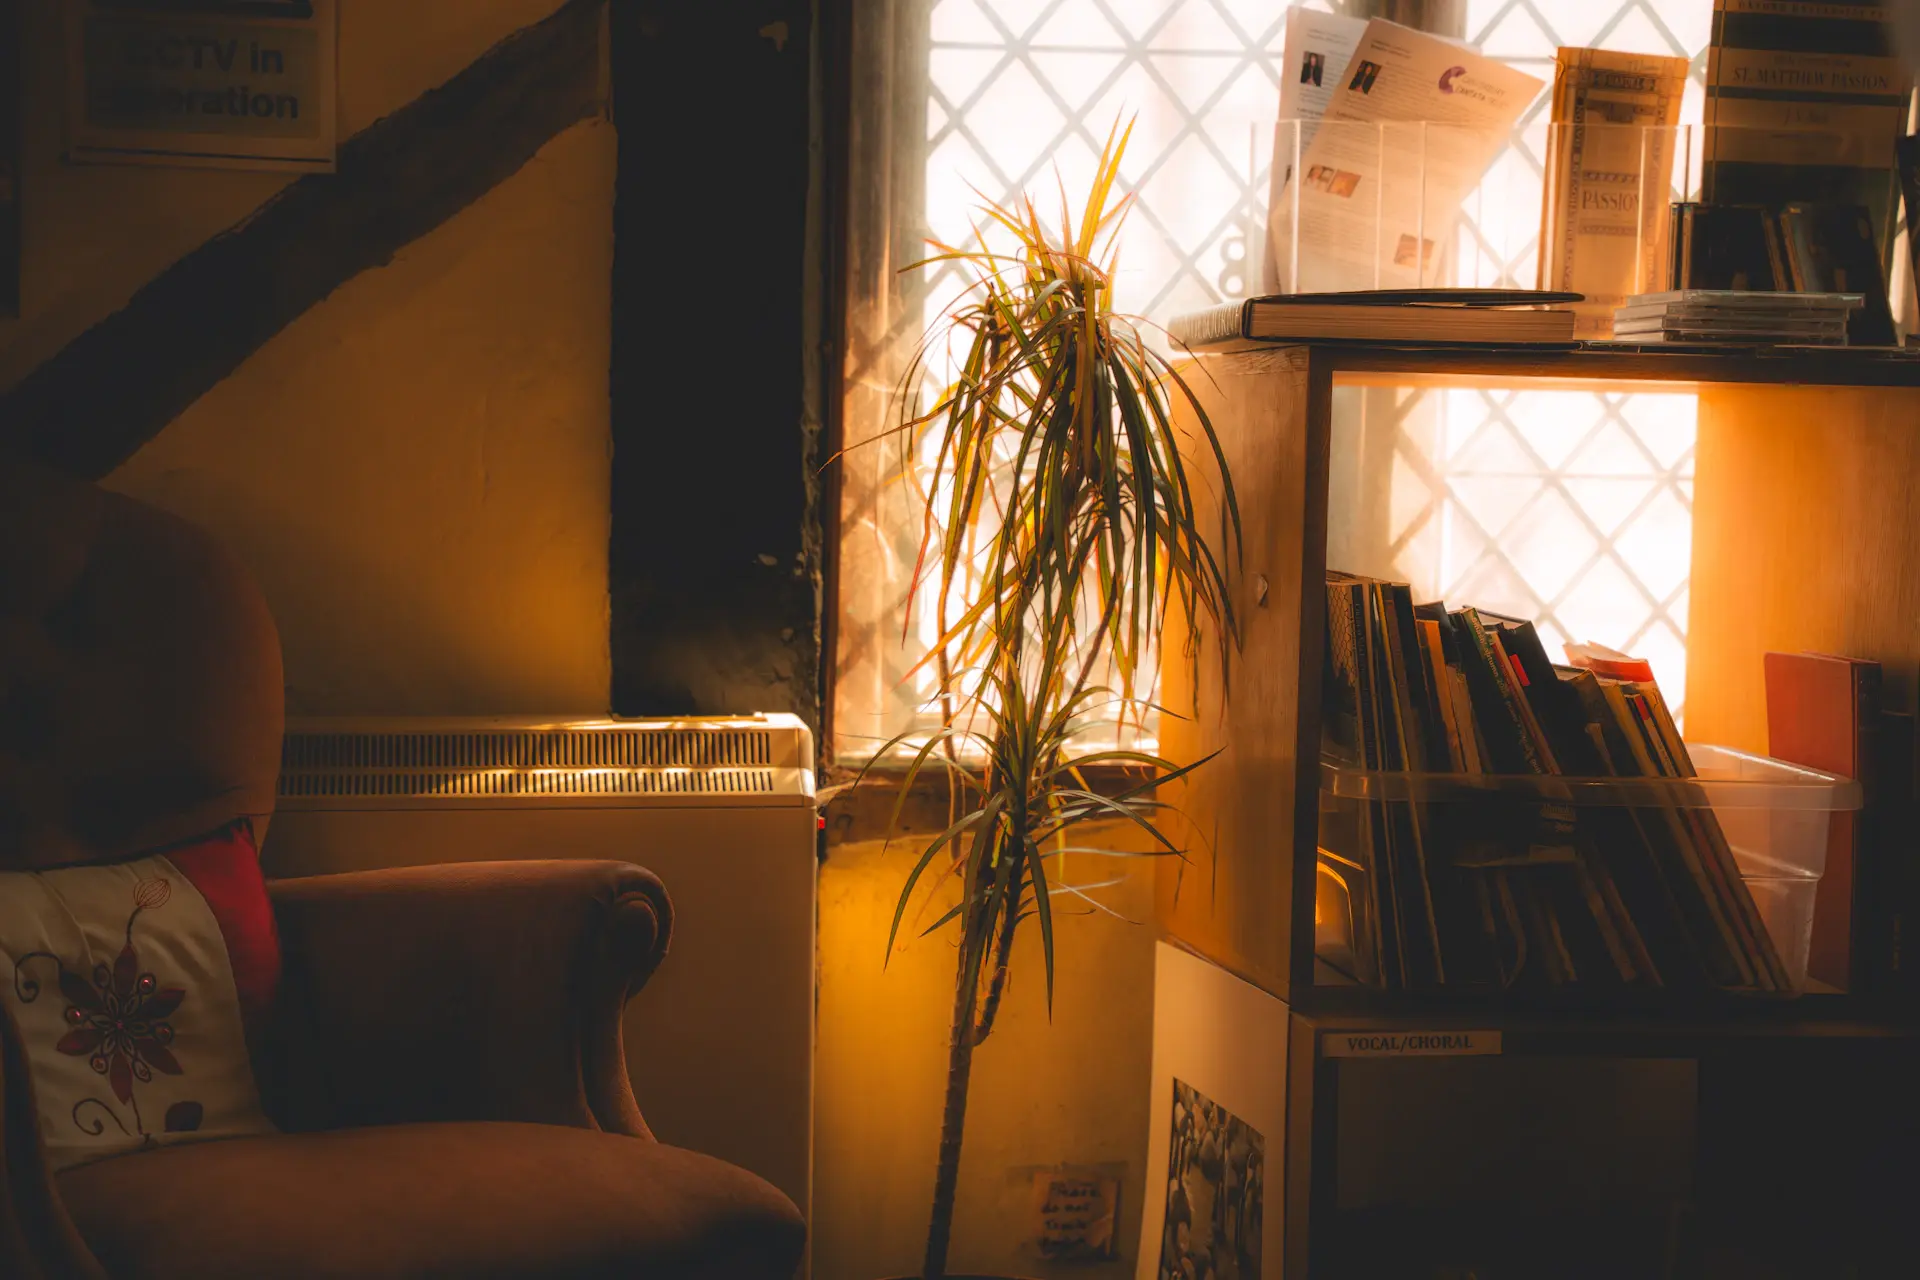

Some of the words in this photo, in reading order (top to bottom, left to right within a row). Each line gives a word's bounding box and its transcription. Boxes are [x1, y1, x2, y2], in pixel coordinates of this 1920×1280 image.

[125, 35, 239, 72] CTV
[250, 41, 284, 74] in
[1757, 68, 1825, 87] MATTHEW
[1831, 73, 1889, 90] PASSION
[110, 85, 299, 121] eration
[1347, 1035, 1473, 1052] VOCAL/CHORAL
